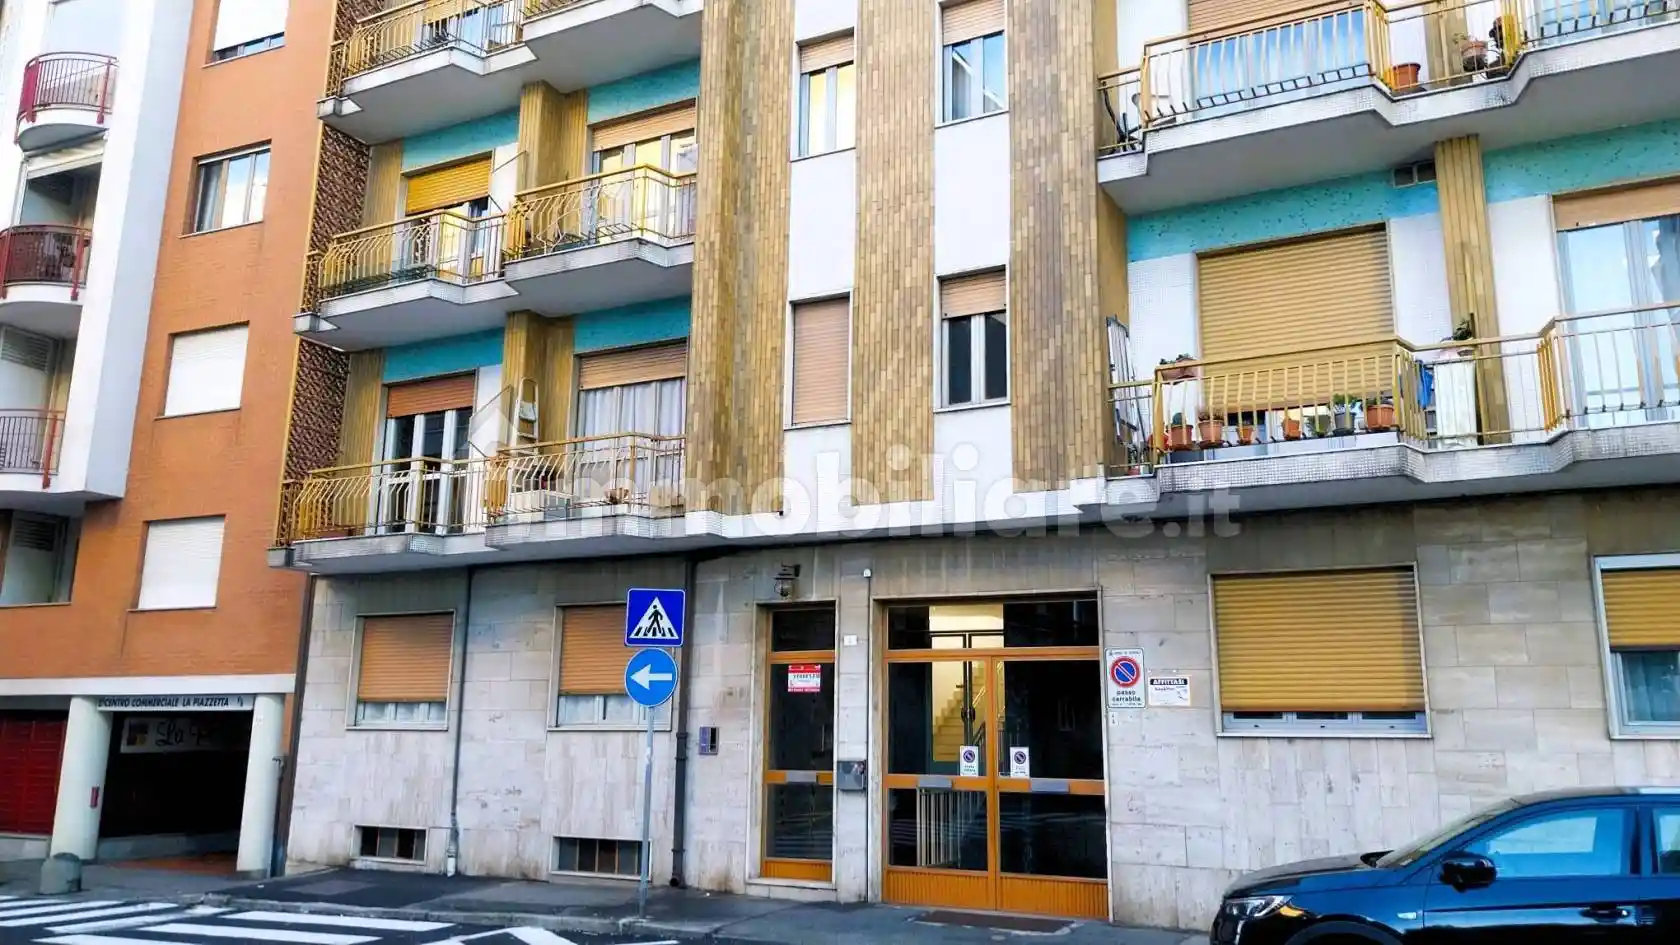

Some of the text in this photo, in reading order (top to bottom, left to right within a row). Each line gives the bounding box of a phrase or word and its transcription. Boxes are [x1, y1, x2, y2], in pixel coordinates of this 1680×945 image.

[131, 697, 179, 708] COMMERCIALE
[182, 697, 191, 707] LA
[192, 697, 229, 707] PIAZZETTA
